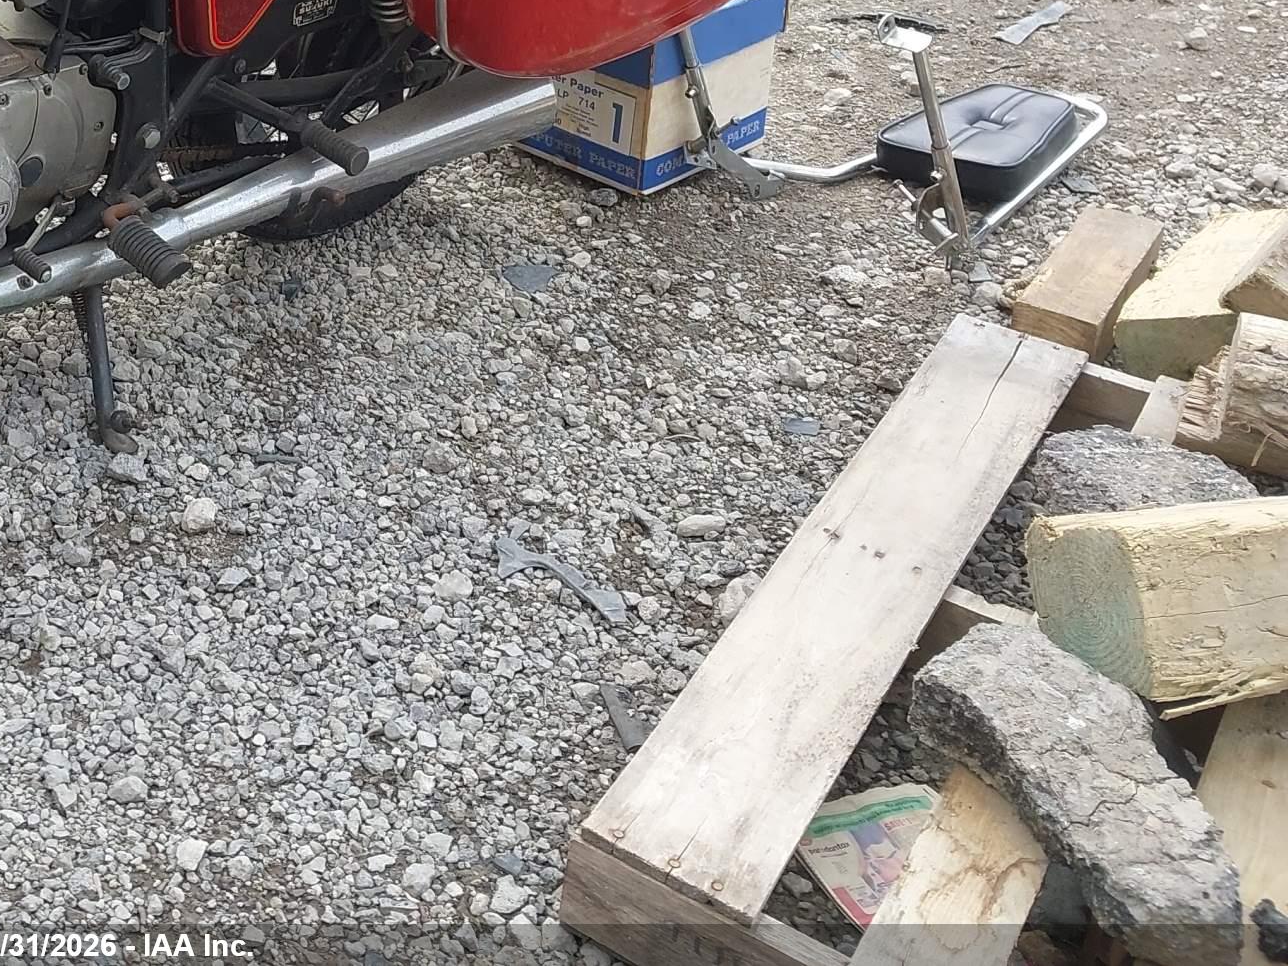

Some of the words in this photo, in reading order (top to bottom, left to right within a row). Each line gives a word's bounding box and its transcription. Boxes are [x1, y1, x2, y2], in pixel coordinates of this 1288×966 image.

[570, 77, 604, 99] Paper
[578, 96, 596, 111] 714
[612, 101, 623, 144] 1
[726, 119, 761, 145] PAPER
[589, 151, 636, 179] PAPER
